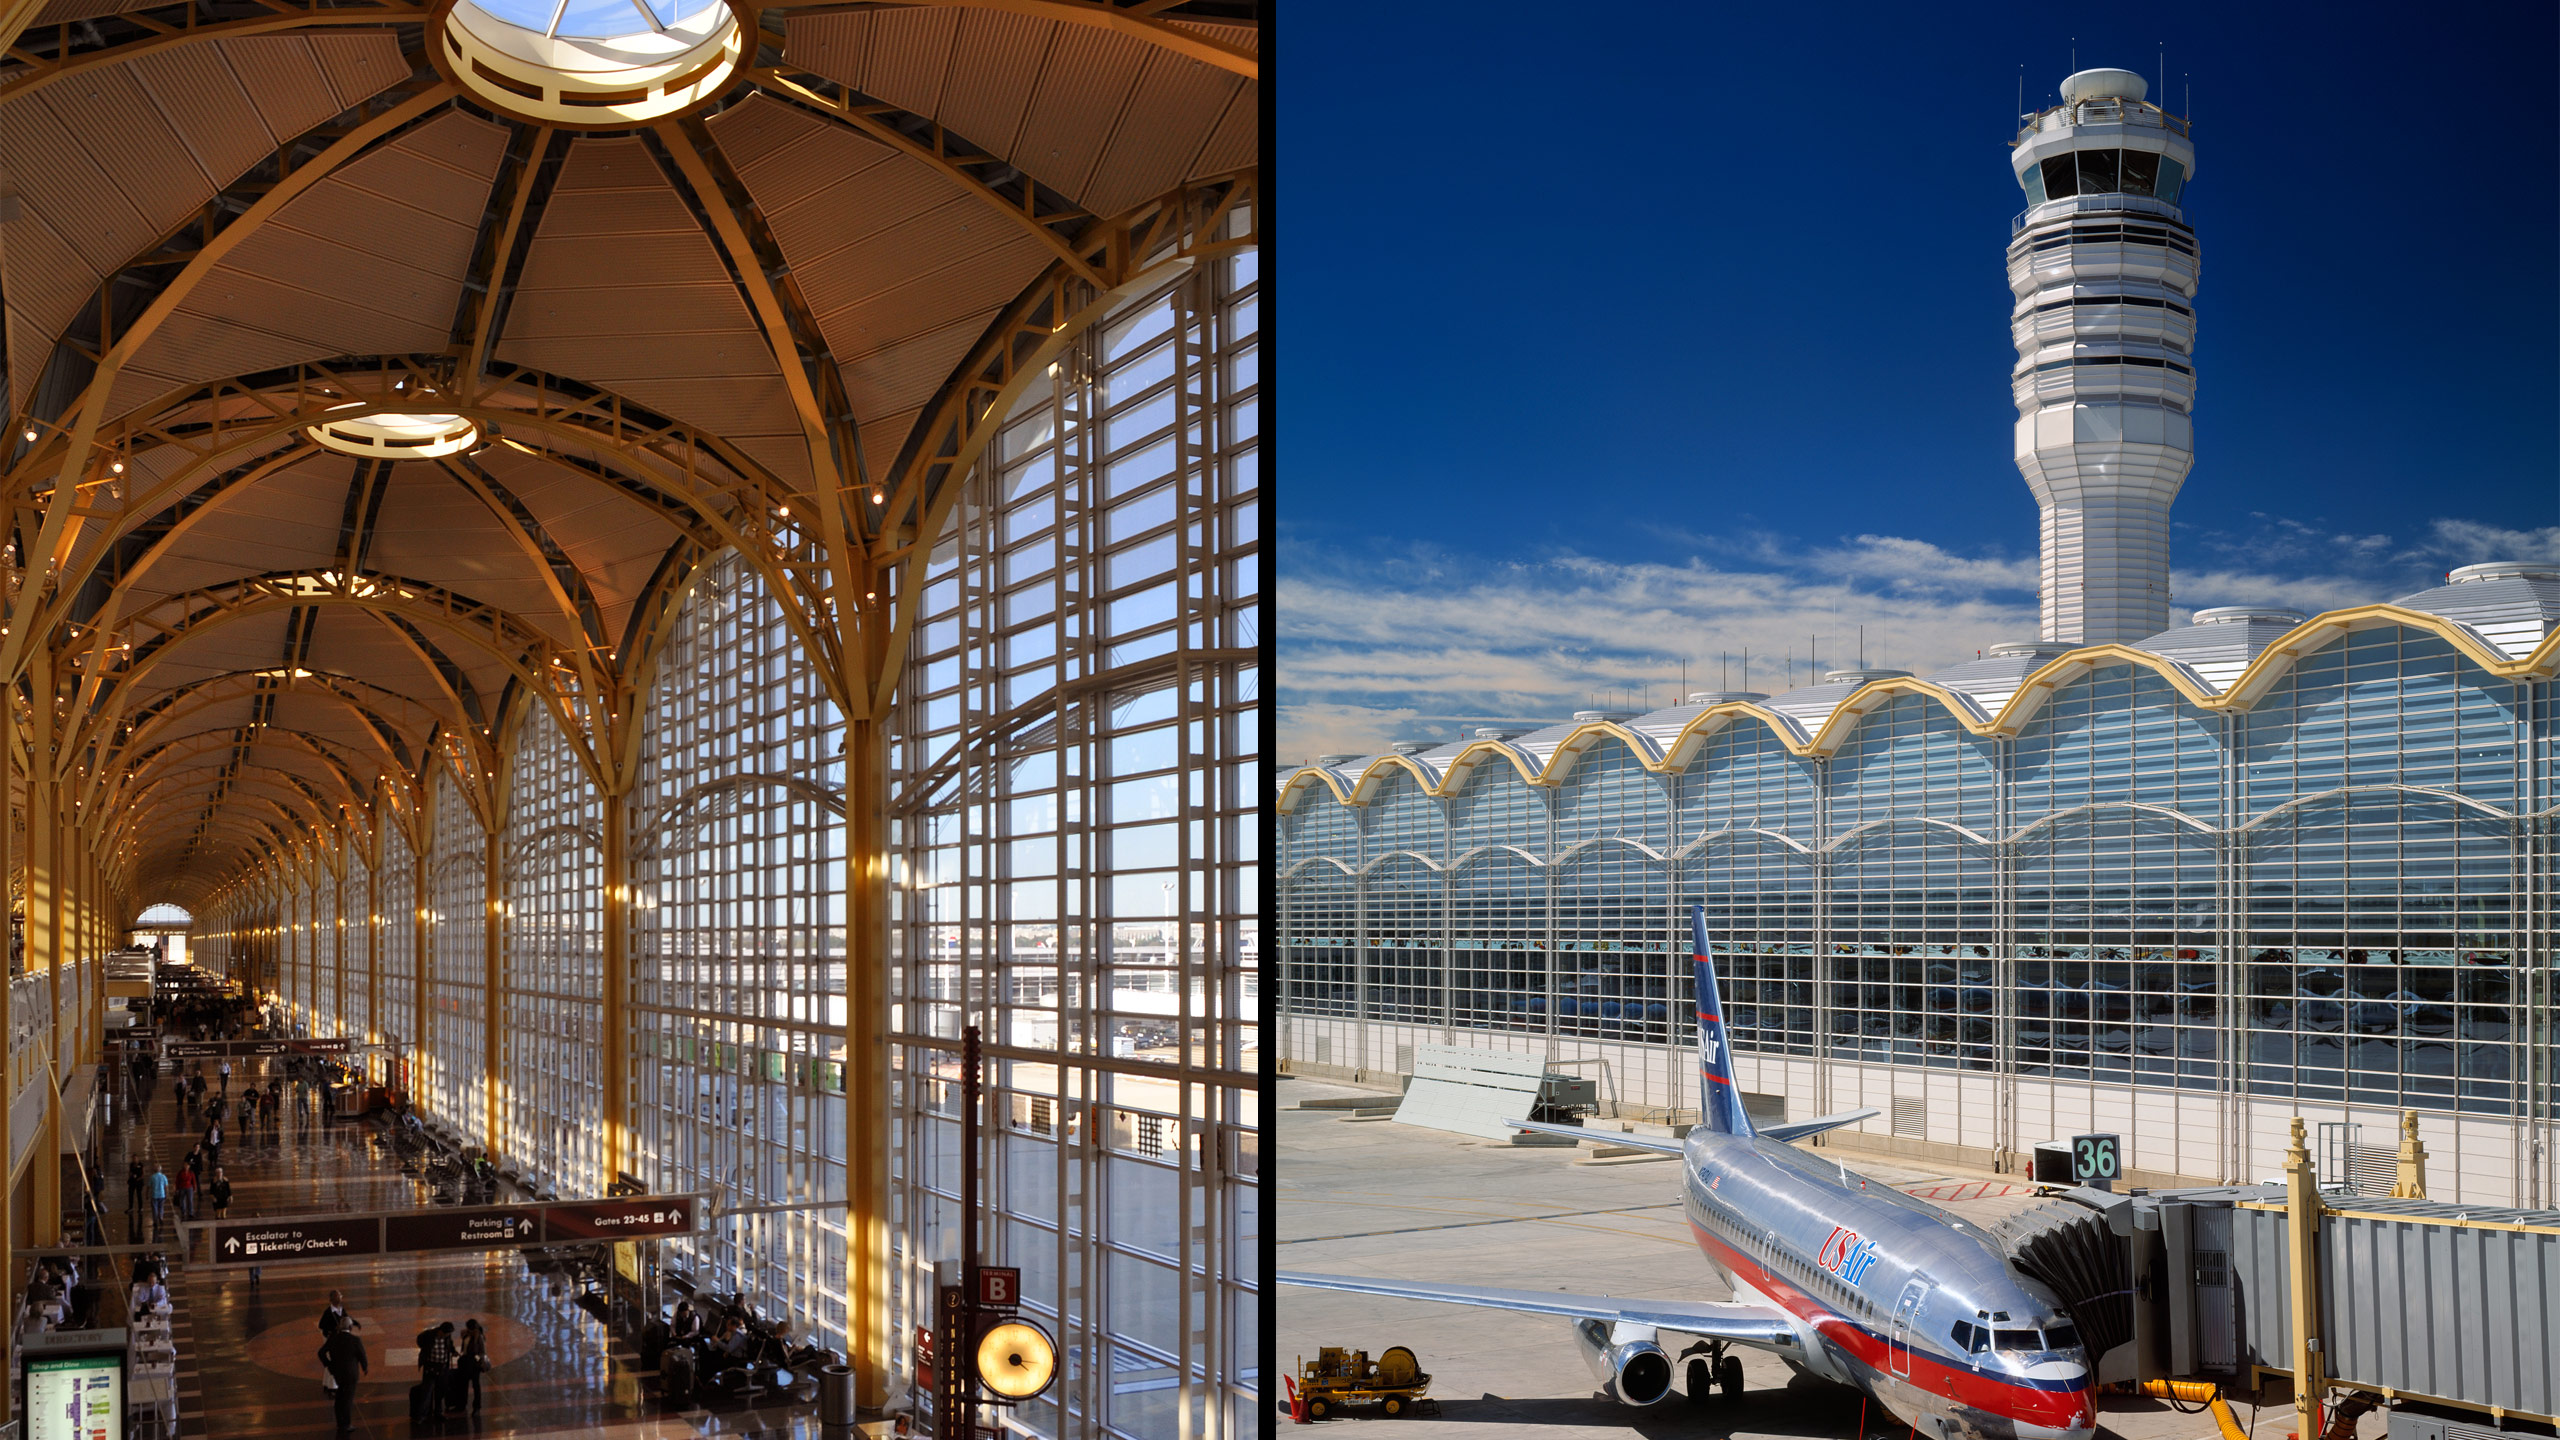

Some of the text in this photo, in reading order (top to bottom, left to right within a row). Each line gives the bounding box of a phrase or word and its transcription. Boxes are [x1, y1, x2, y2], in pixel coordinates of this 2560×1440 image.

[2077, 1139, 2115, 1178] 36
[469, 1219, 502, 1229] Parking
[595, 1215, 649, 1226] Gates 23-45
[246, 1231, 288, 1240] Escalator
[461, 1230, 502, 1240] Restroom
[260, 1238, 347, 1251] Ticketing/Check-In
[1818, 1225, 1877, 1288] USAir
[990, 1277, 1006, 1300] B
